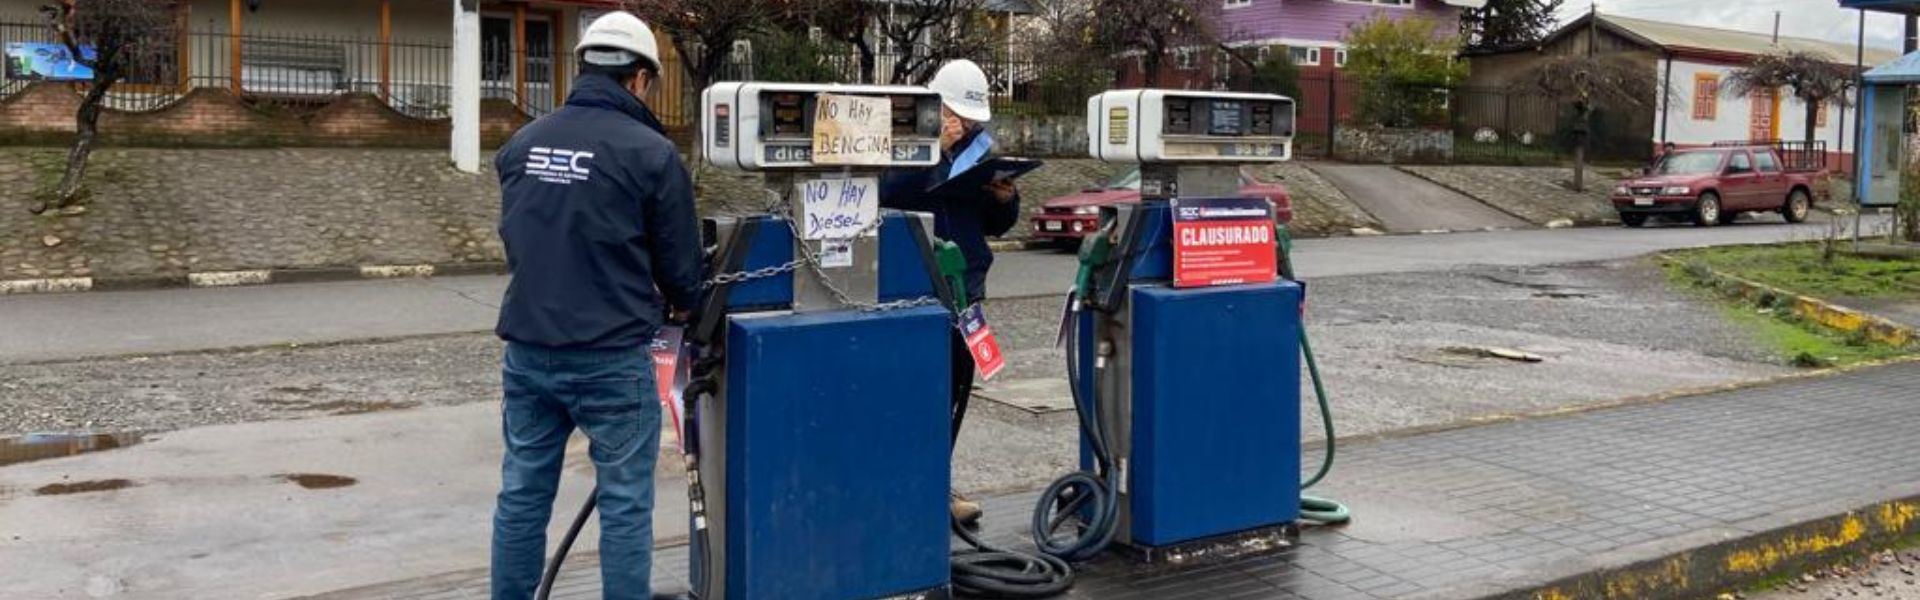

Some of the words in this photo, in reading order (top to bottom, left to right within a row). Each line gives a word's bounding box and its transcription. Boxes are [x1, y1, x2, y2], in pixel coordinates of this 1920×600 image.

[818, 98, 839, 120] NO
[848, 98, 873, 125] HAY
[526, 147, 595, 174] SEC
[895, 145, 919, 160] SP
[806, 181, 828, 203] NO
[838, 180, 867, 208] HAY
[1181, 225, 1269, 247] CLAUSURADO
